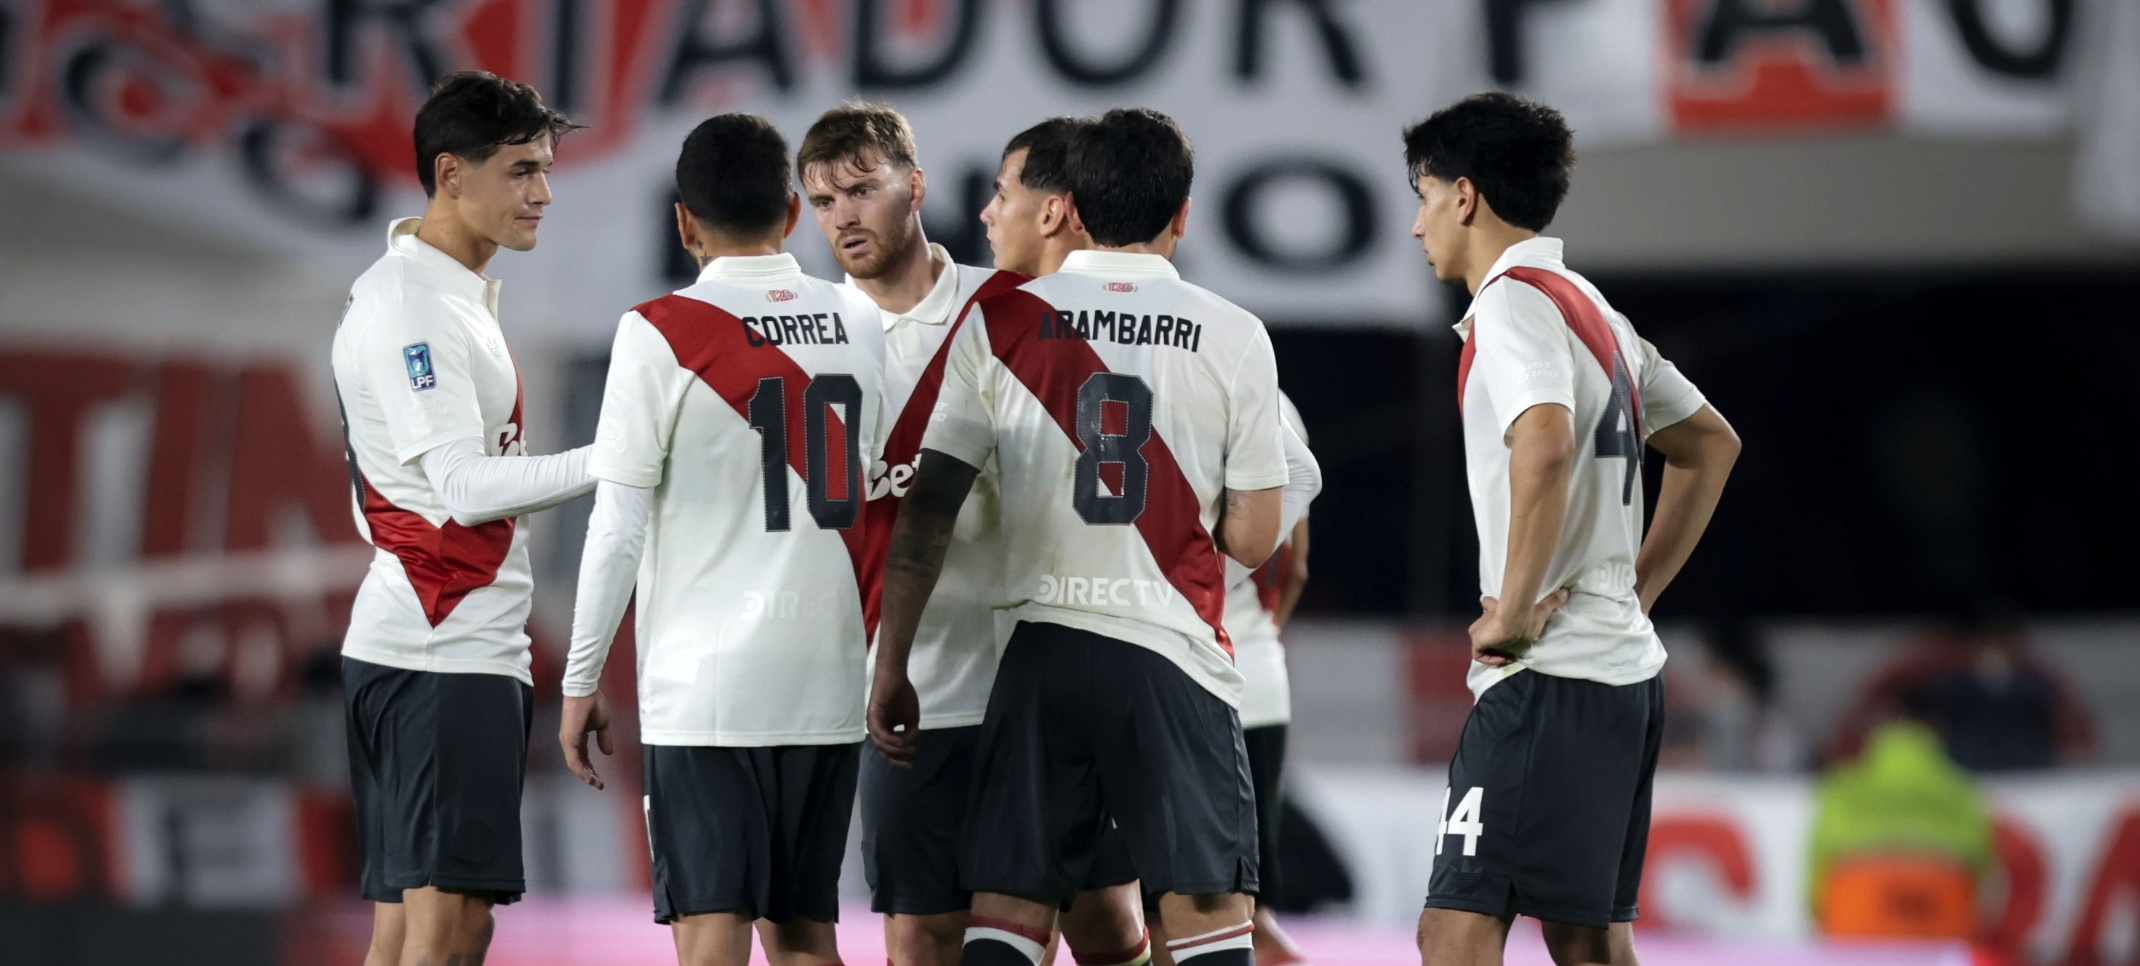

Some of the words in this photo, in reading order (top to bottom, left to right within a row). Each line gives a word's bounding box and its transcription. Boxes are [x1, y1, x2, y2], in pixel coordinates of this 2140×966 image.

[742, 312, 849, 348] CORREA
[1037, 310, 1202, 353] ARAMBARRI
[410, 374, 434, 390] LPF
[1072, 371, 1154, 527] 8
[1594, 350, 1646, 506] 4
[748, 373, 863, 533] 10
[1037, 574, 1175, 608] DIRECTV
